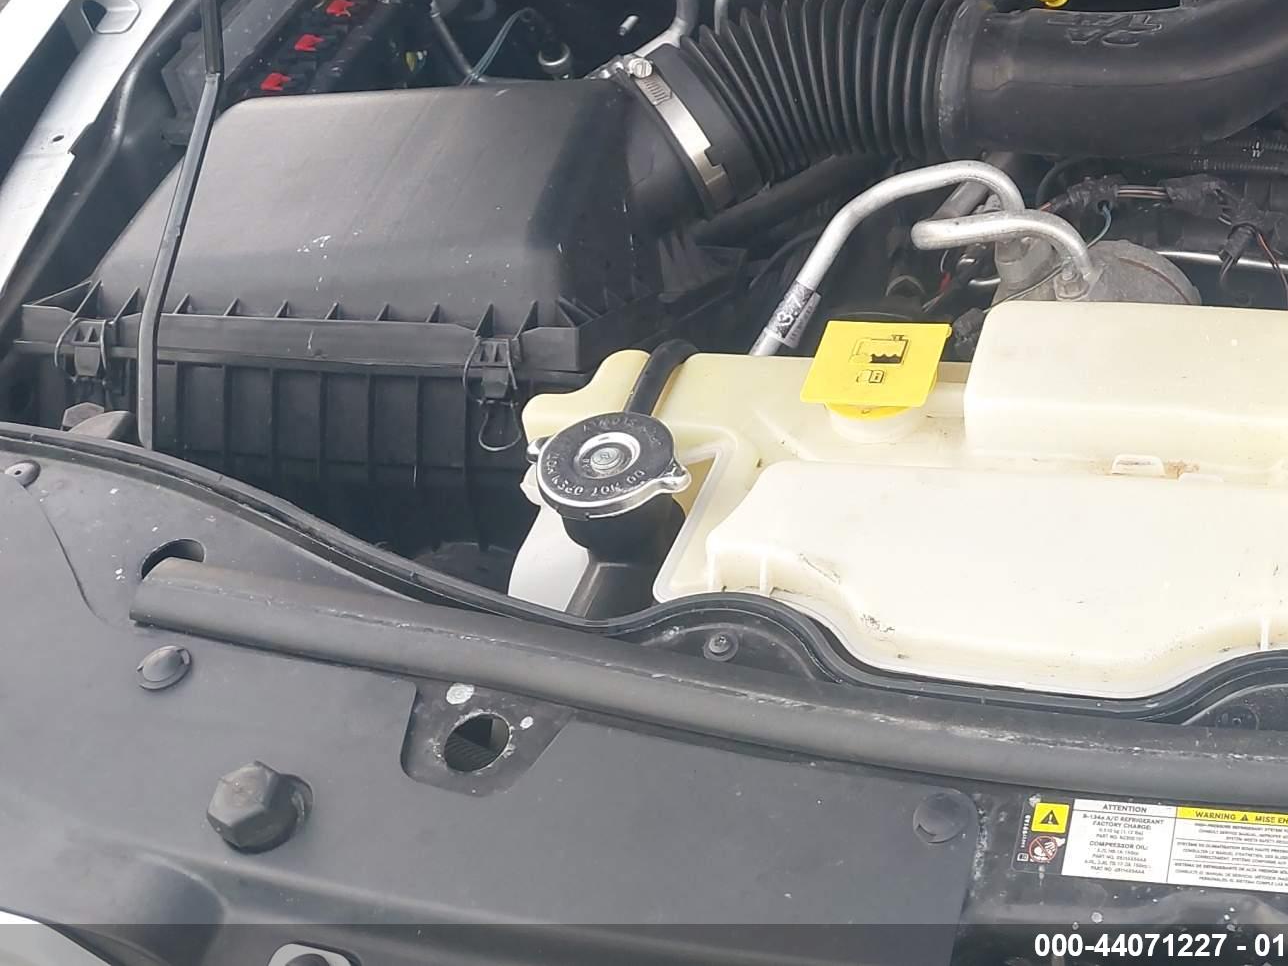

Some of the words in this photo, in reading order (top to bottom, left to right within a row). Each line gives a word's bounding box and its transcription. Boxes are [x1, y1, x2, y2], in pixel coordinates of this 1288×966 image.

[591, 482, 620, 496] NOT
[1102, 803, 1147, 813] ATTENTION
[1120, 817, 1164, 825] REFRIGERANT
[1194, 810, 1237, 821] WARNING
[1254, 815, 1275, 823] MISE
[1089, 841, 1134, 849] COMPRESSOR
